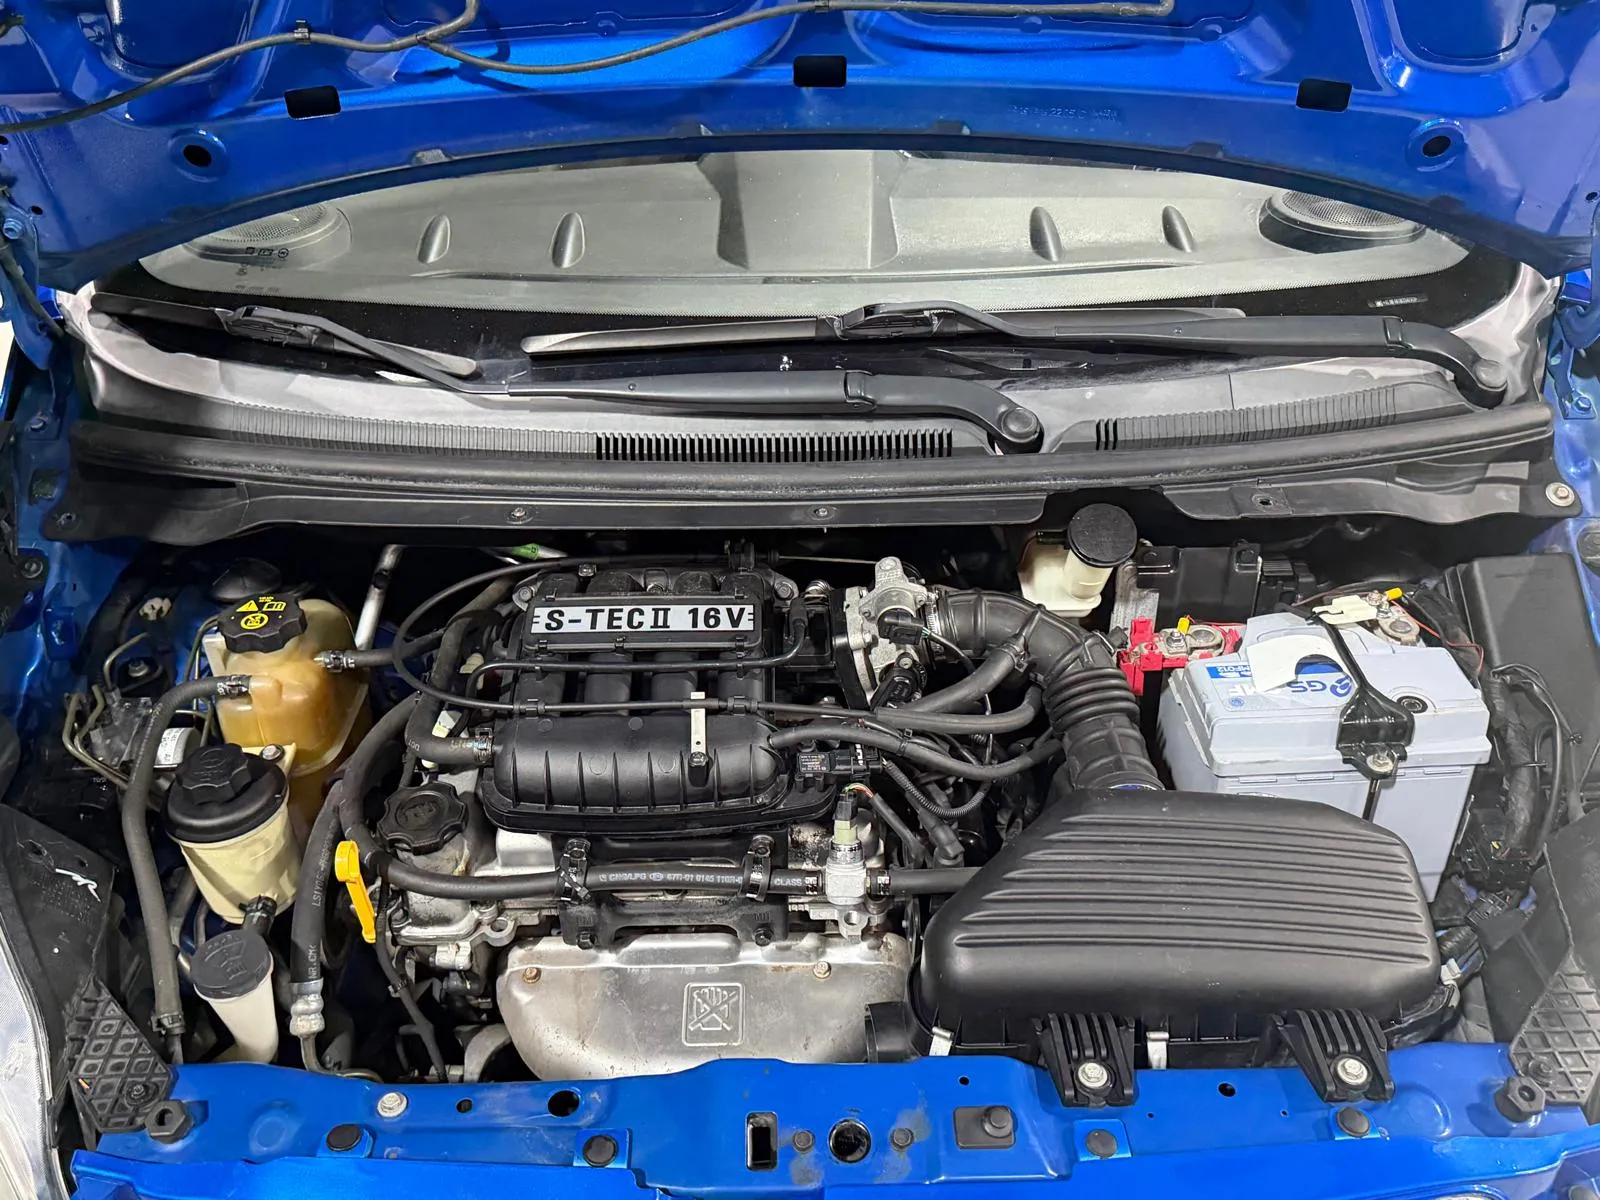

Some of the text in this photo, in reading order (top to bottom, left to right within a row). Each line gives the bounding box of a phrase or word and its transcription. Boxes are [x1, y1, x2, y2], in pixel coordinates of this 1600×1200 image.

[688, 606, 746, 630] 16V
[1286, 680, 1327, 693] GS
[774, 878, 801, 887] CLASS
